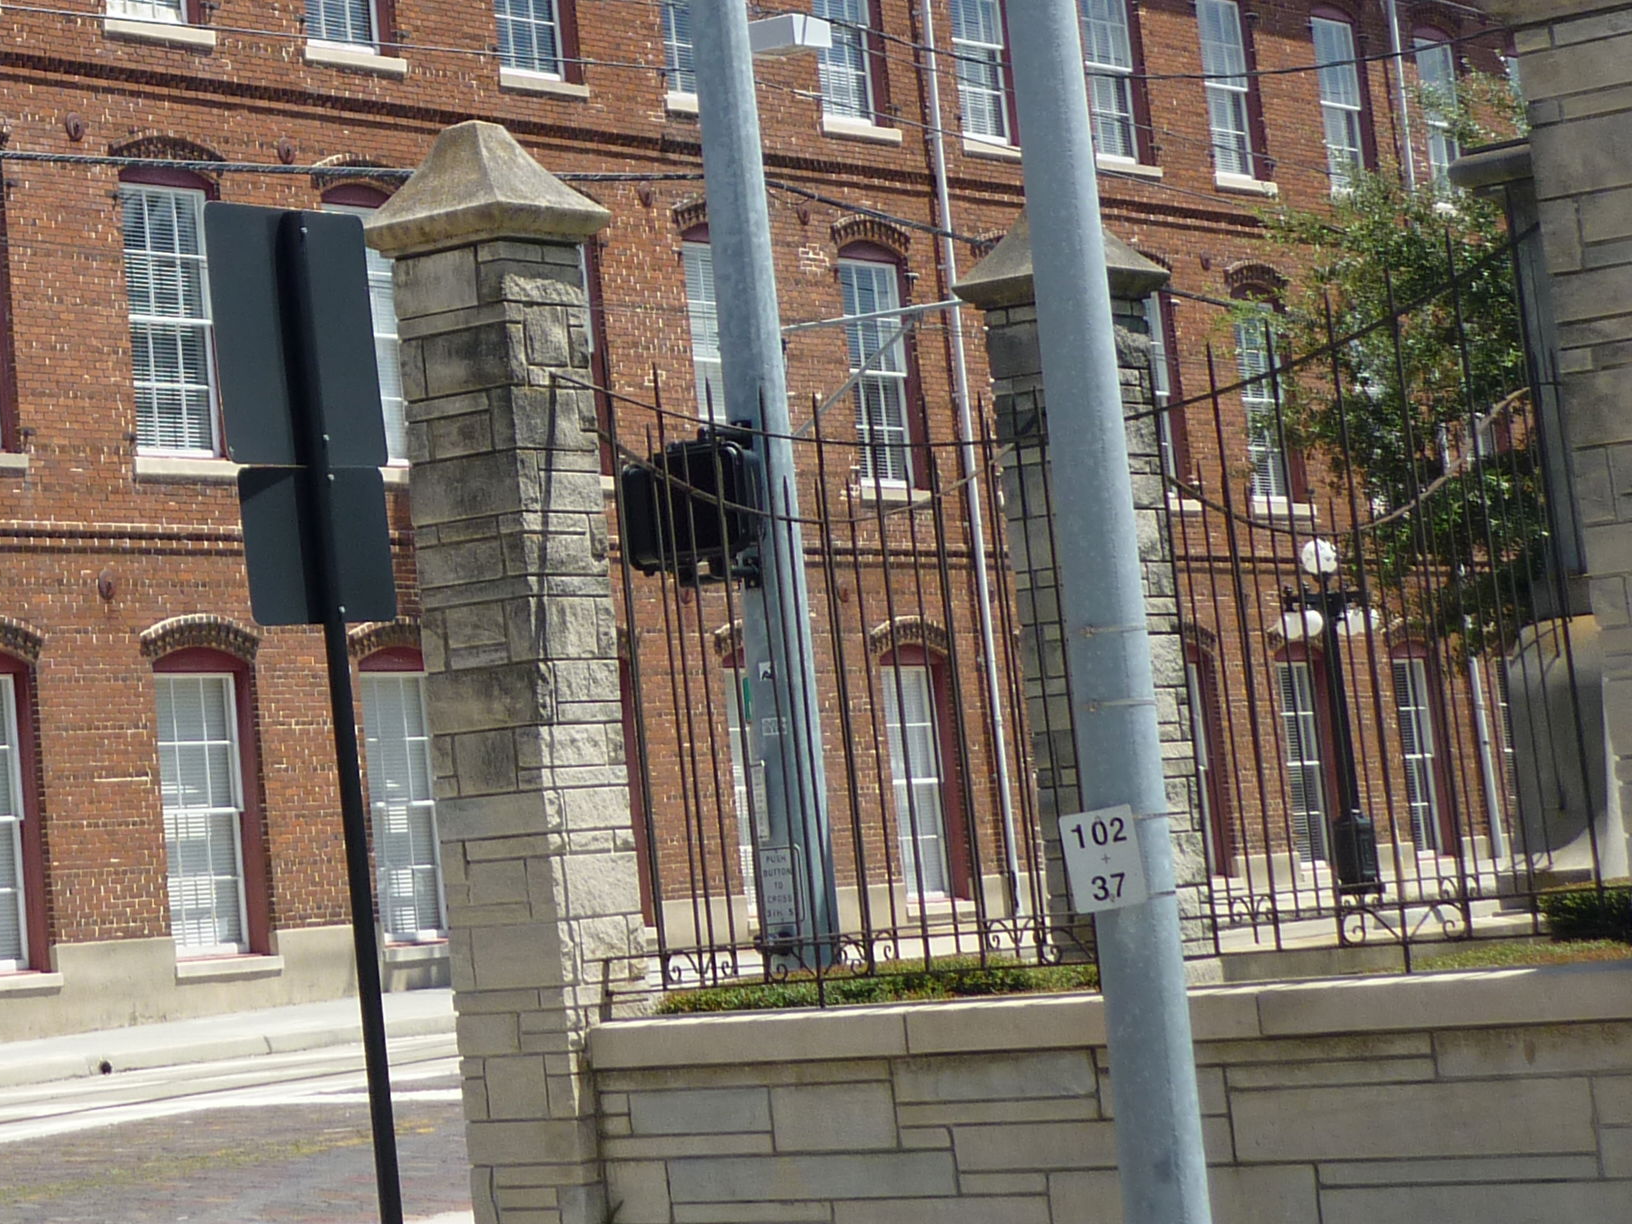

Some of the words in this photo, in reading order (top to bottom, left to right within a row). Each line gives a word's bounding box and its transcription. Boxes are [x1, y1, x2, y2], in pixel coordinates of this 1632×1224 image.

[1071, 817, 1127, 849] 102
[766, 855, 786, 864] PUSH
[763, 868, 792, 878] BUTTON
[774, 881, 783, 890] TO
[1091, 872, 1125, 902] 37
